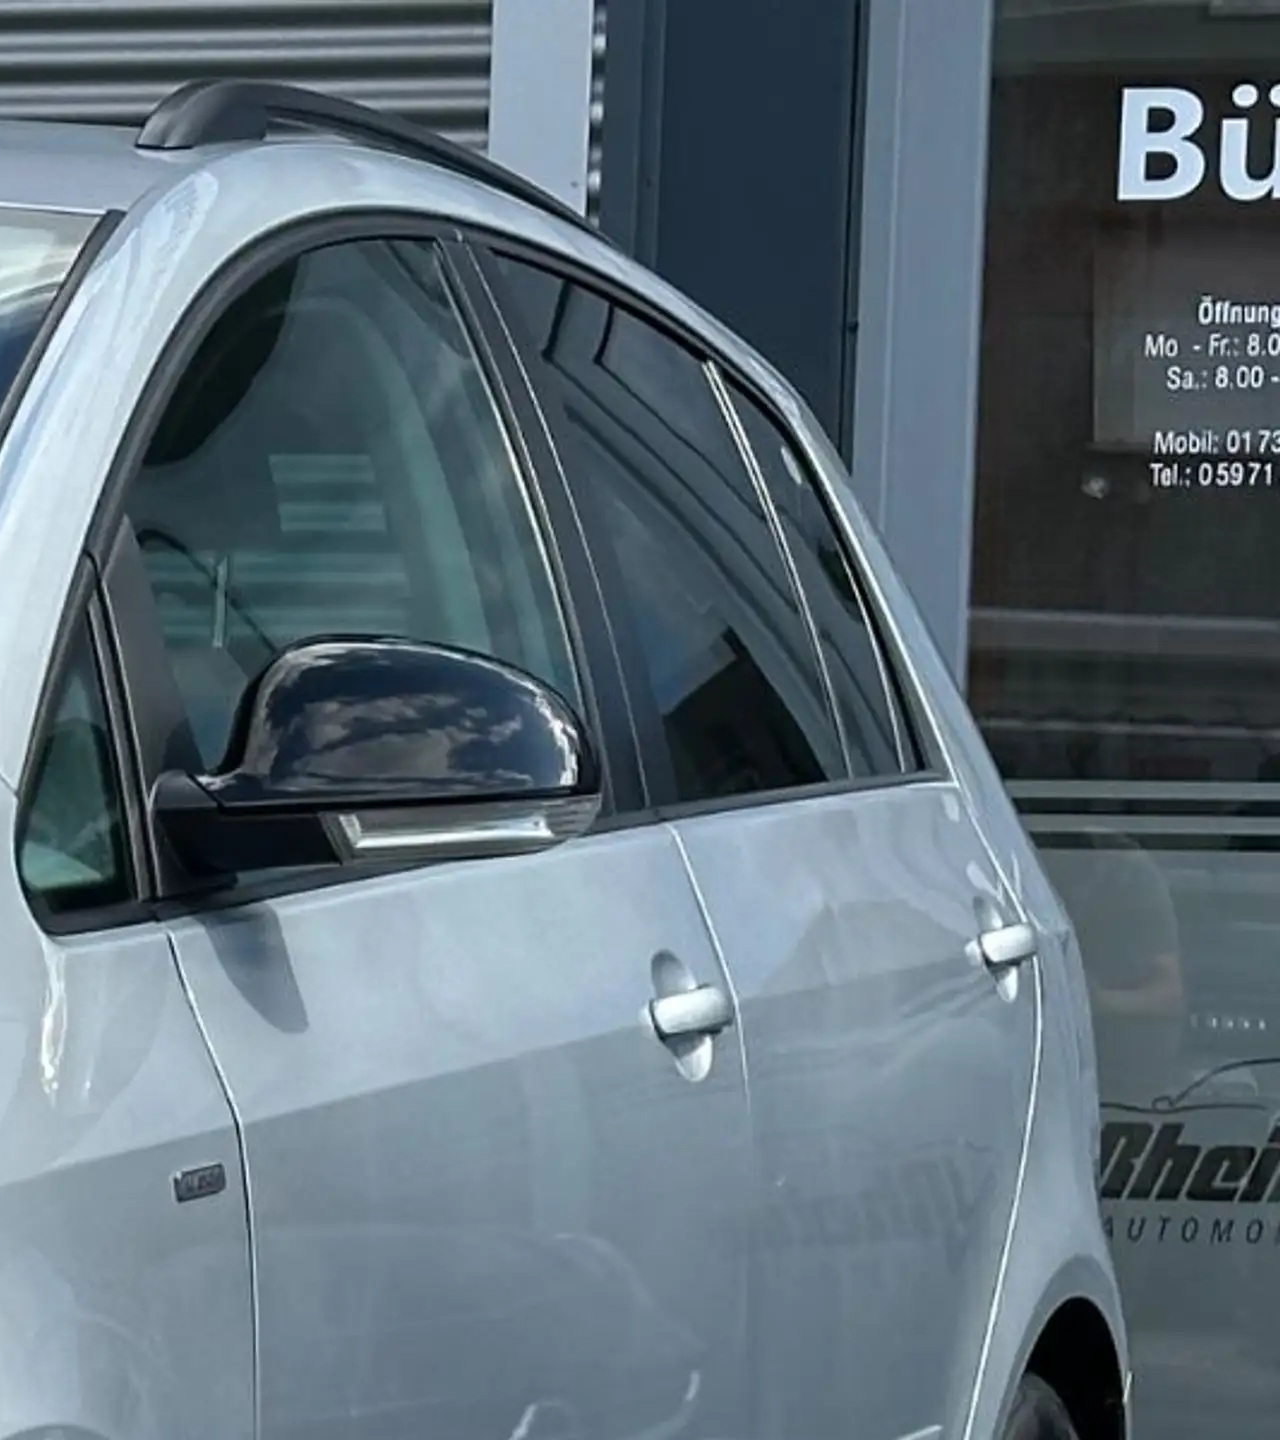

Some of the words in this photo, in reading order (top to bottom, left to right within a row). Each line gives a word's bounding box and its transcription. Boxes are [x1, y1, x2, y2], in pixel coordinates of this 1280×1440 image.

[1117, 84, 1280, 202] Bü
[1145, 333, 1179, 358] Mo
[1166, 365, 1208, 390] Sa.:
[1215, 365, 1264, 390] 8.00
[1154, 429, 1219, 455] Mobil:
[1198, 461, 1272, 487] 05971
[1100, 1122, 1280, 1202] Rhei
[1102, 1214, 1280, 1245] AUTOMO
